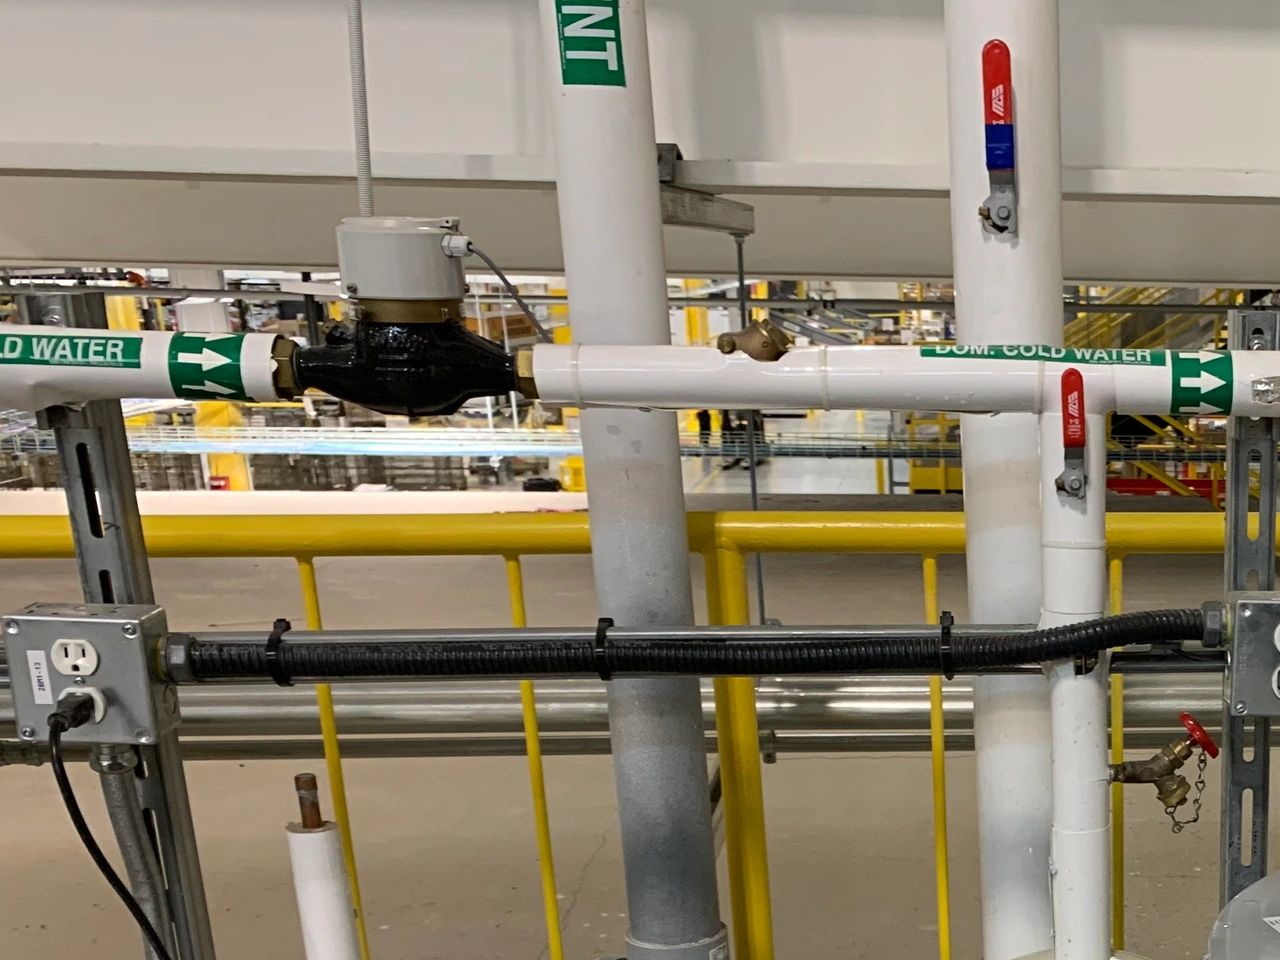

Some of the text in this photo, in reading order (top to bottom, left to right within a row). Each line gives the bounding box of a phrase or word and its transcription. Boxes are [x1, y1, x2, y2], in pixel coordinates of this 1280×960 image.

[31, 337, 125, 362] WATER
[1003, 345, 1065, 359] COLD
[1073, 347, 1151, 362] WATER
